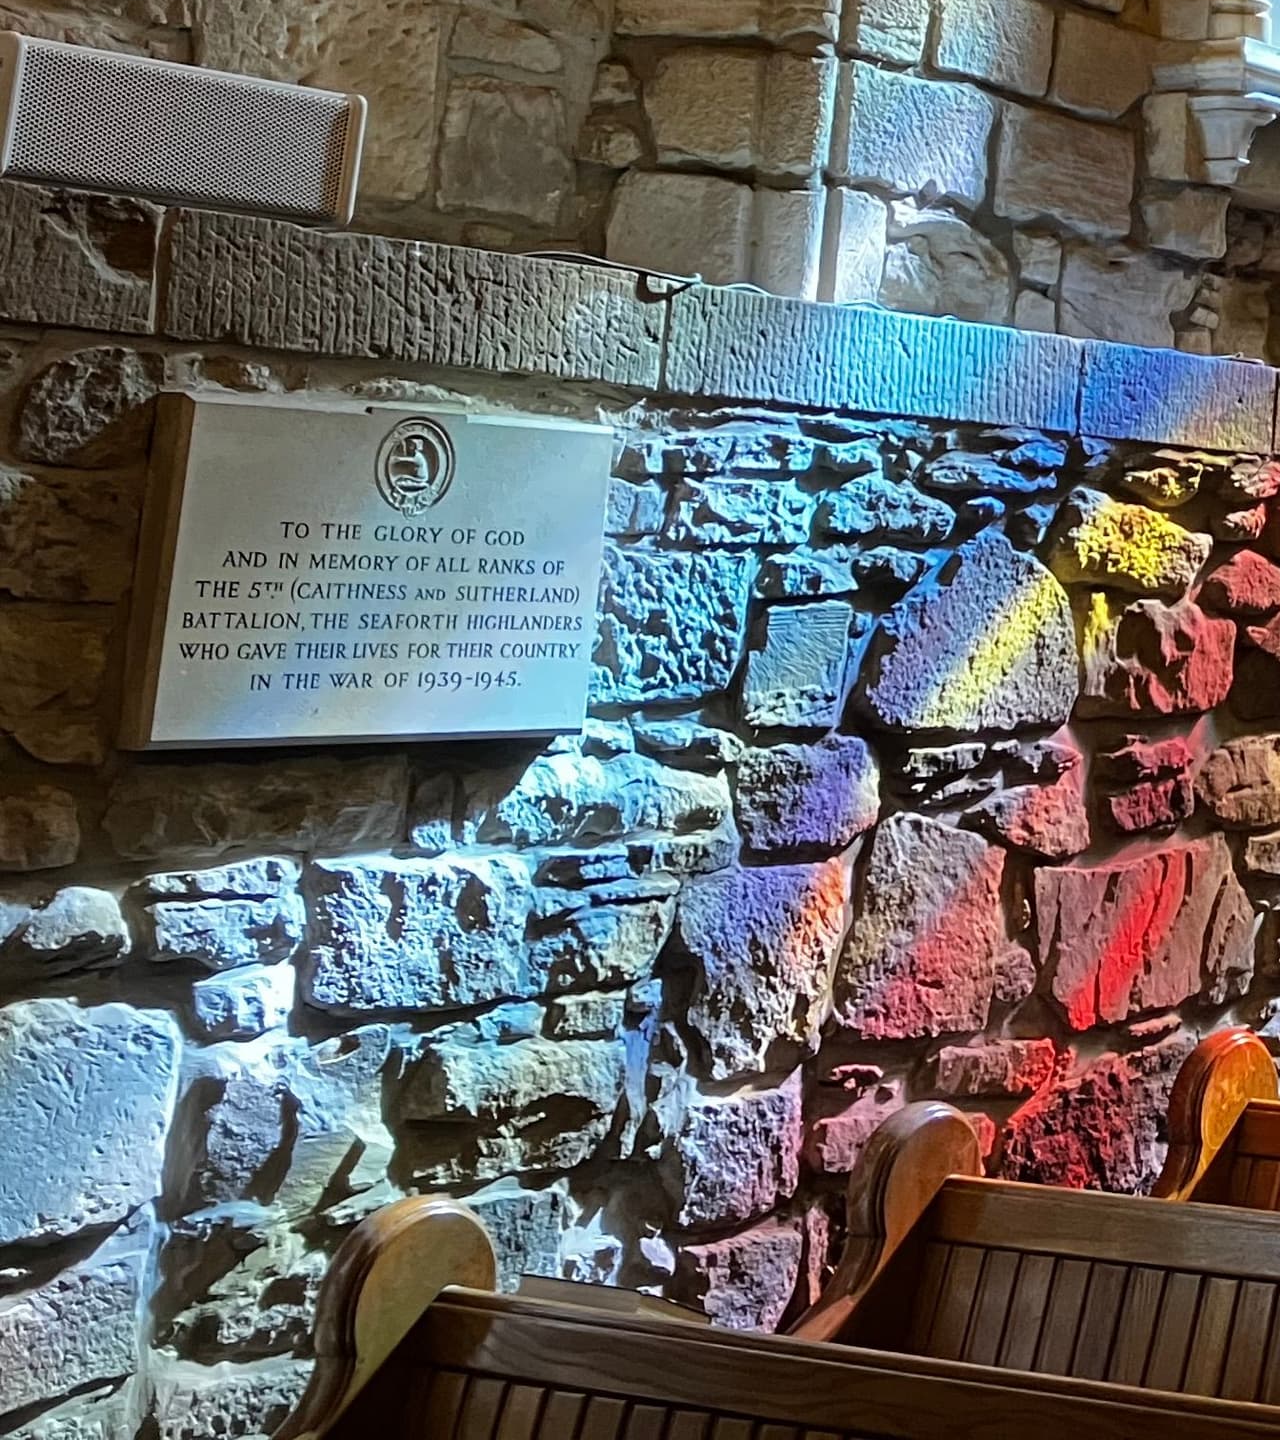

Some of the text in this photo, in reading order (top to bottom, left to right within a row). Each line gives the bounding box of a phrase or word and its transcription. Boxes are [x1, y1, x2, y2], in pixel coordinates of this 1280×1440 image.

[280, 521, 526, 546] TO THE GLORY OF GOD
[222, 550, 565, 576] AND IN MEMORY OF ALL RANKS OF
[195, 580, 241, 599] THE
[290, 576, 408, 604] (CAITHNESS
[414, 587, 447, 601] AND
[455, 585, 581, 606] SUTHERLAND)
[182, 612, 584, 633] BATTALION, THE SEAFORTH HIGHLANDERS
[179, 642, 582, 661] WHO GAVE THEIR LIVES FOR THEIR COUNTRY
[249, 673, 272, 691] IN
[281, 672, 321, 690] THE
[329, 672, 374, 689] WAR
[384, 671, 410, 688] OF
